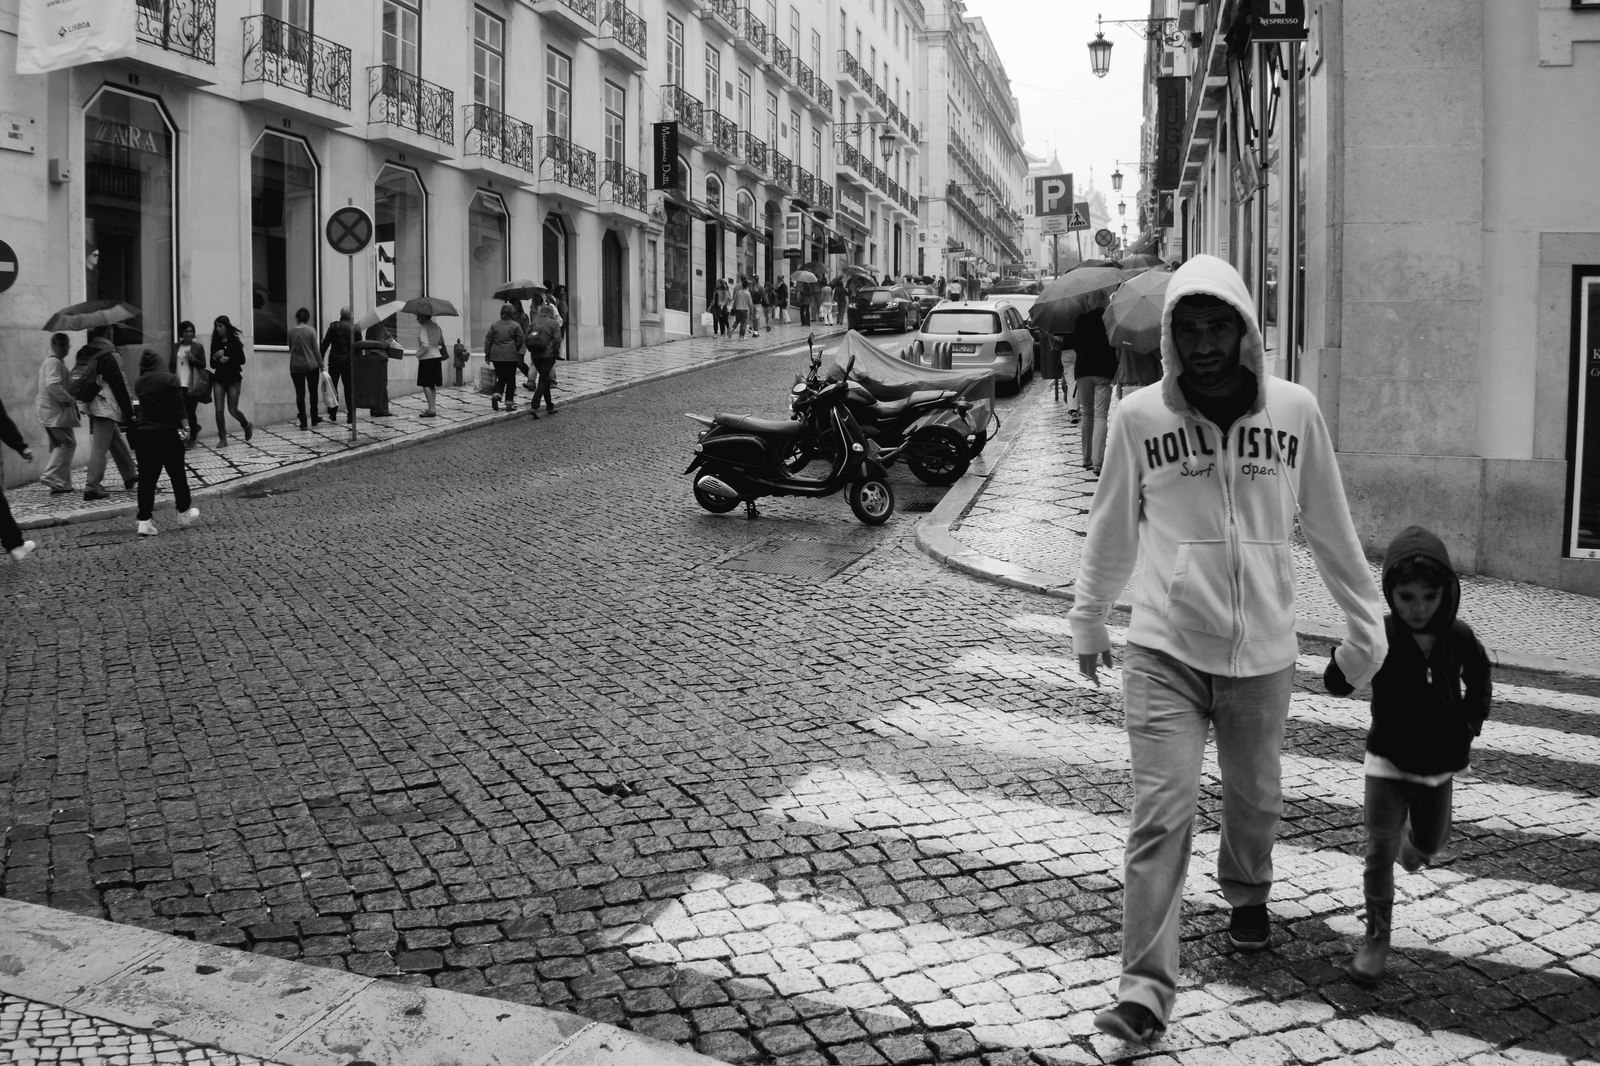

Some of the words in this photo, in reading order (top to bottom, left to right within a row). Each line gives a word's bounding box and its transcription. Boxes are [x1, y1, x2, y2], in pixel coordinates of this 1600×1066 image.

[68, 21, 91, 32] LISBOA
[1259, 16, 1299, 26] NESPRESSO
[96, 120, 158, 153] ZARA
[1042, 179, 1065, 213] P
